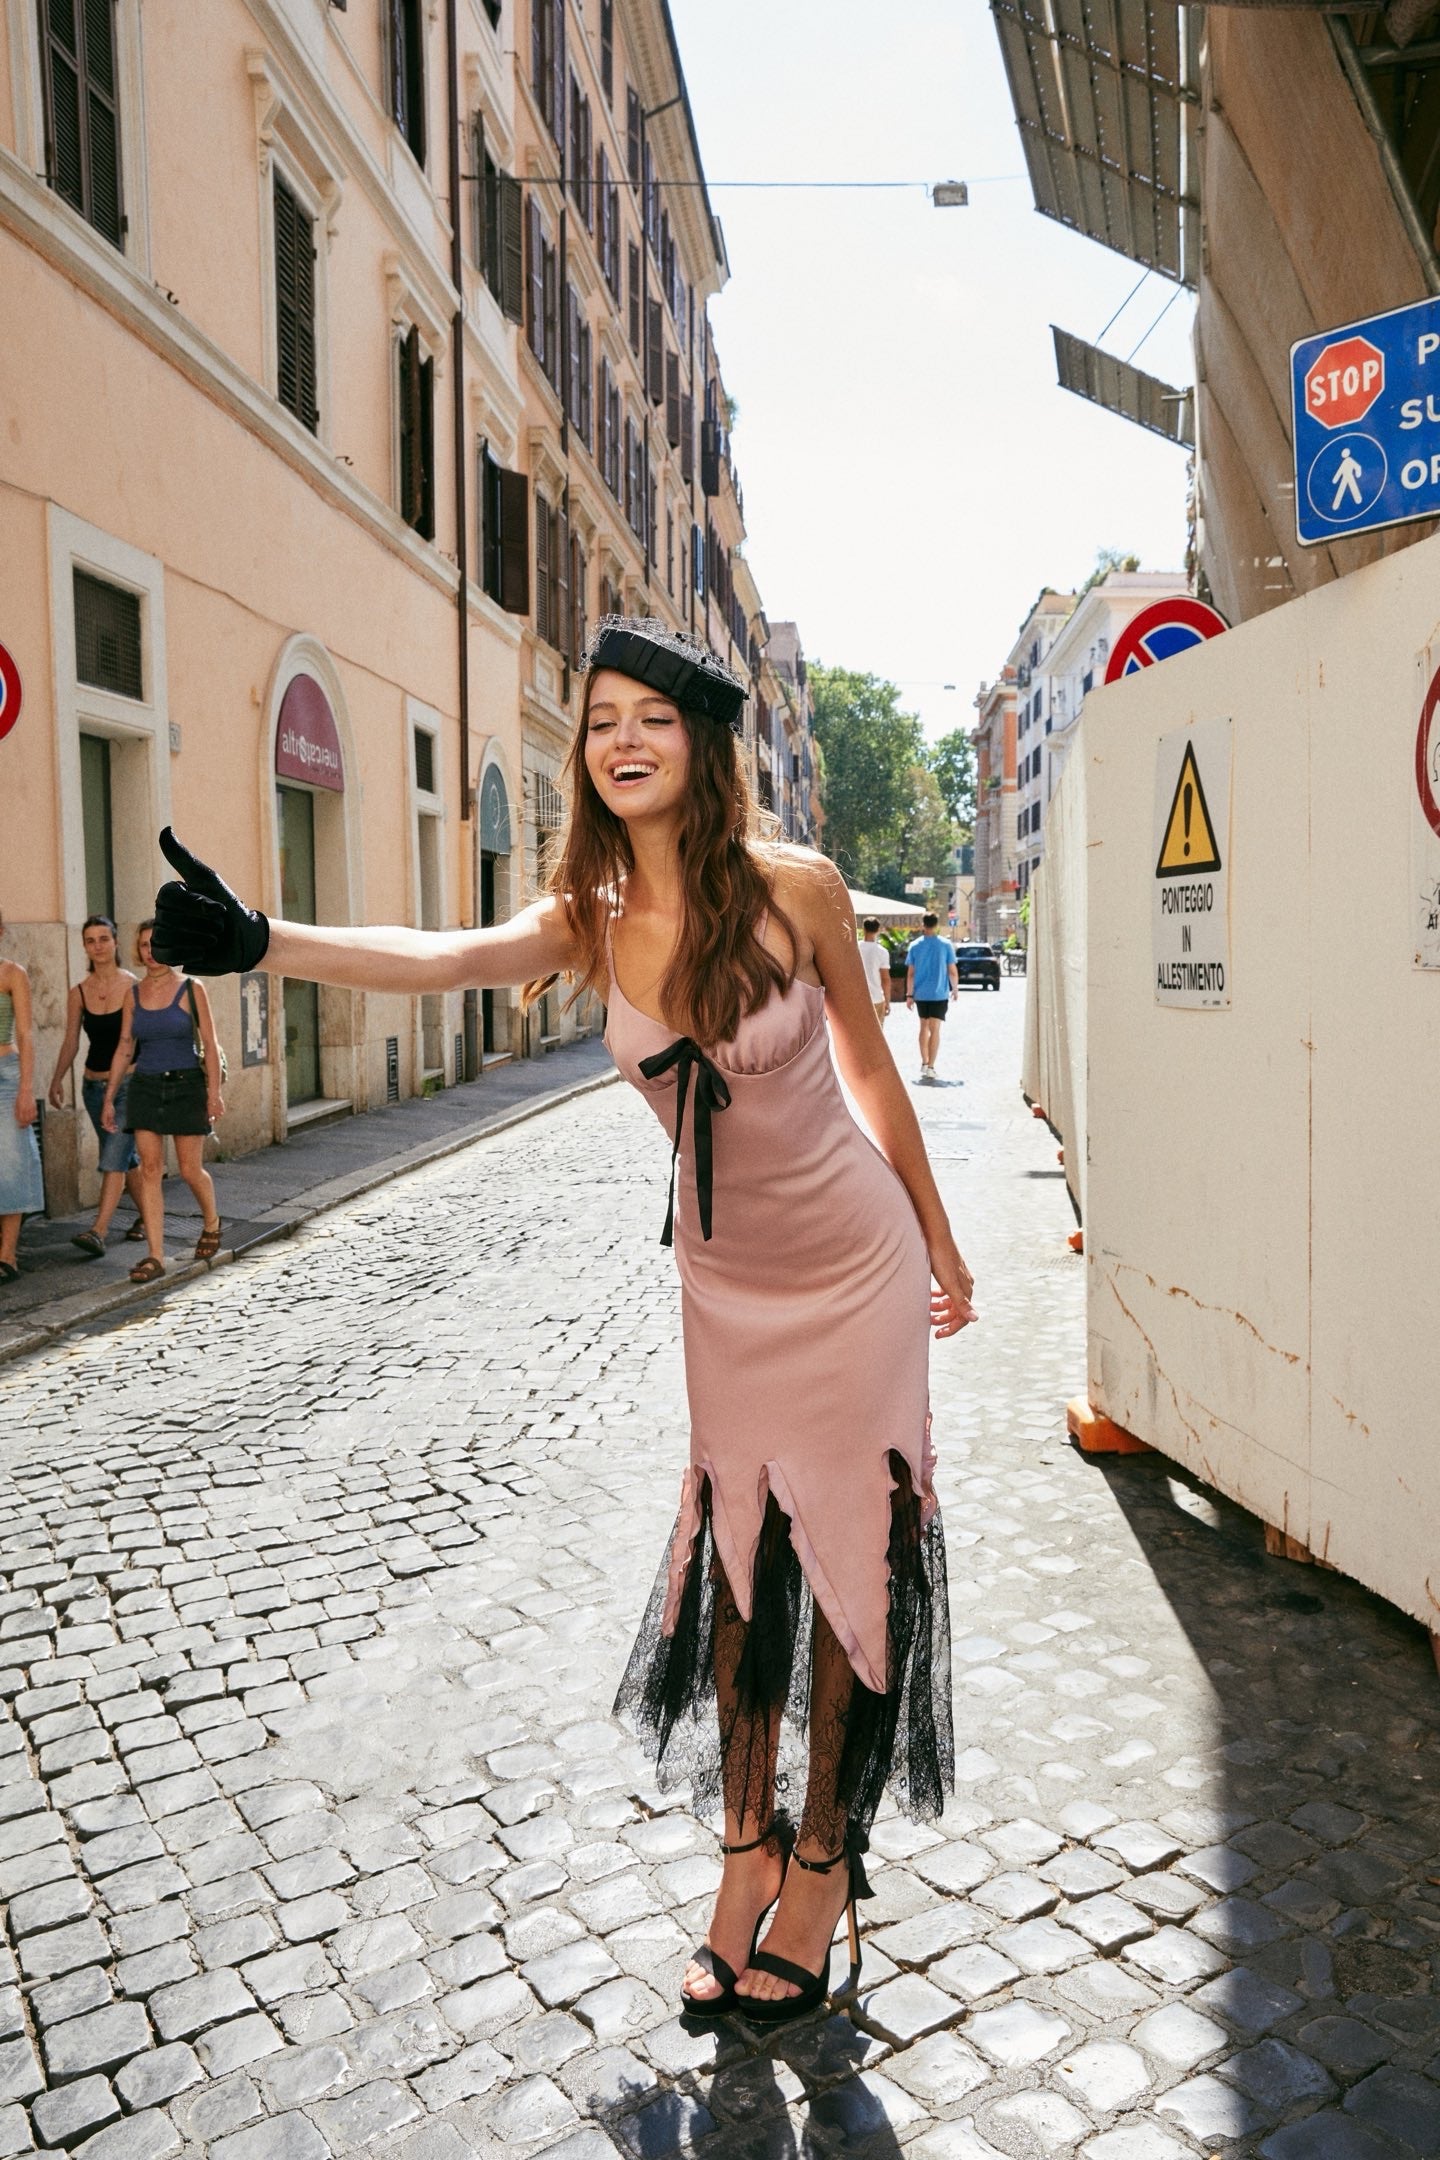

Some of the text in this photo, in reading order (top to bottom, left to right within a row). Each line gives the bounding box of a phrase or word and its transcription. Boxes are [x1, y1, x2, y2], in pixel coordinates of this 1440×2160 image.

[1310, 359, 1379, 407] STOP
[1161, 882, 1214, 915] PONTEGGIO
[1182, 925, 1192, 952] IN
[1157, 962, 1225, 992] ALLESTIMENTO
